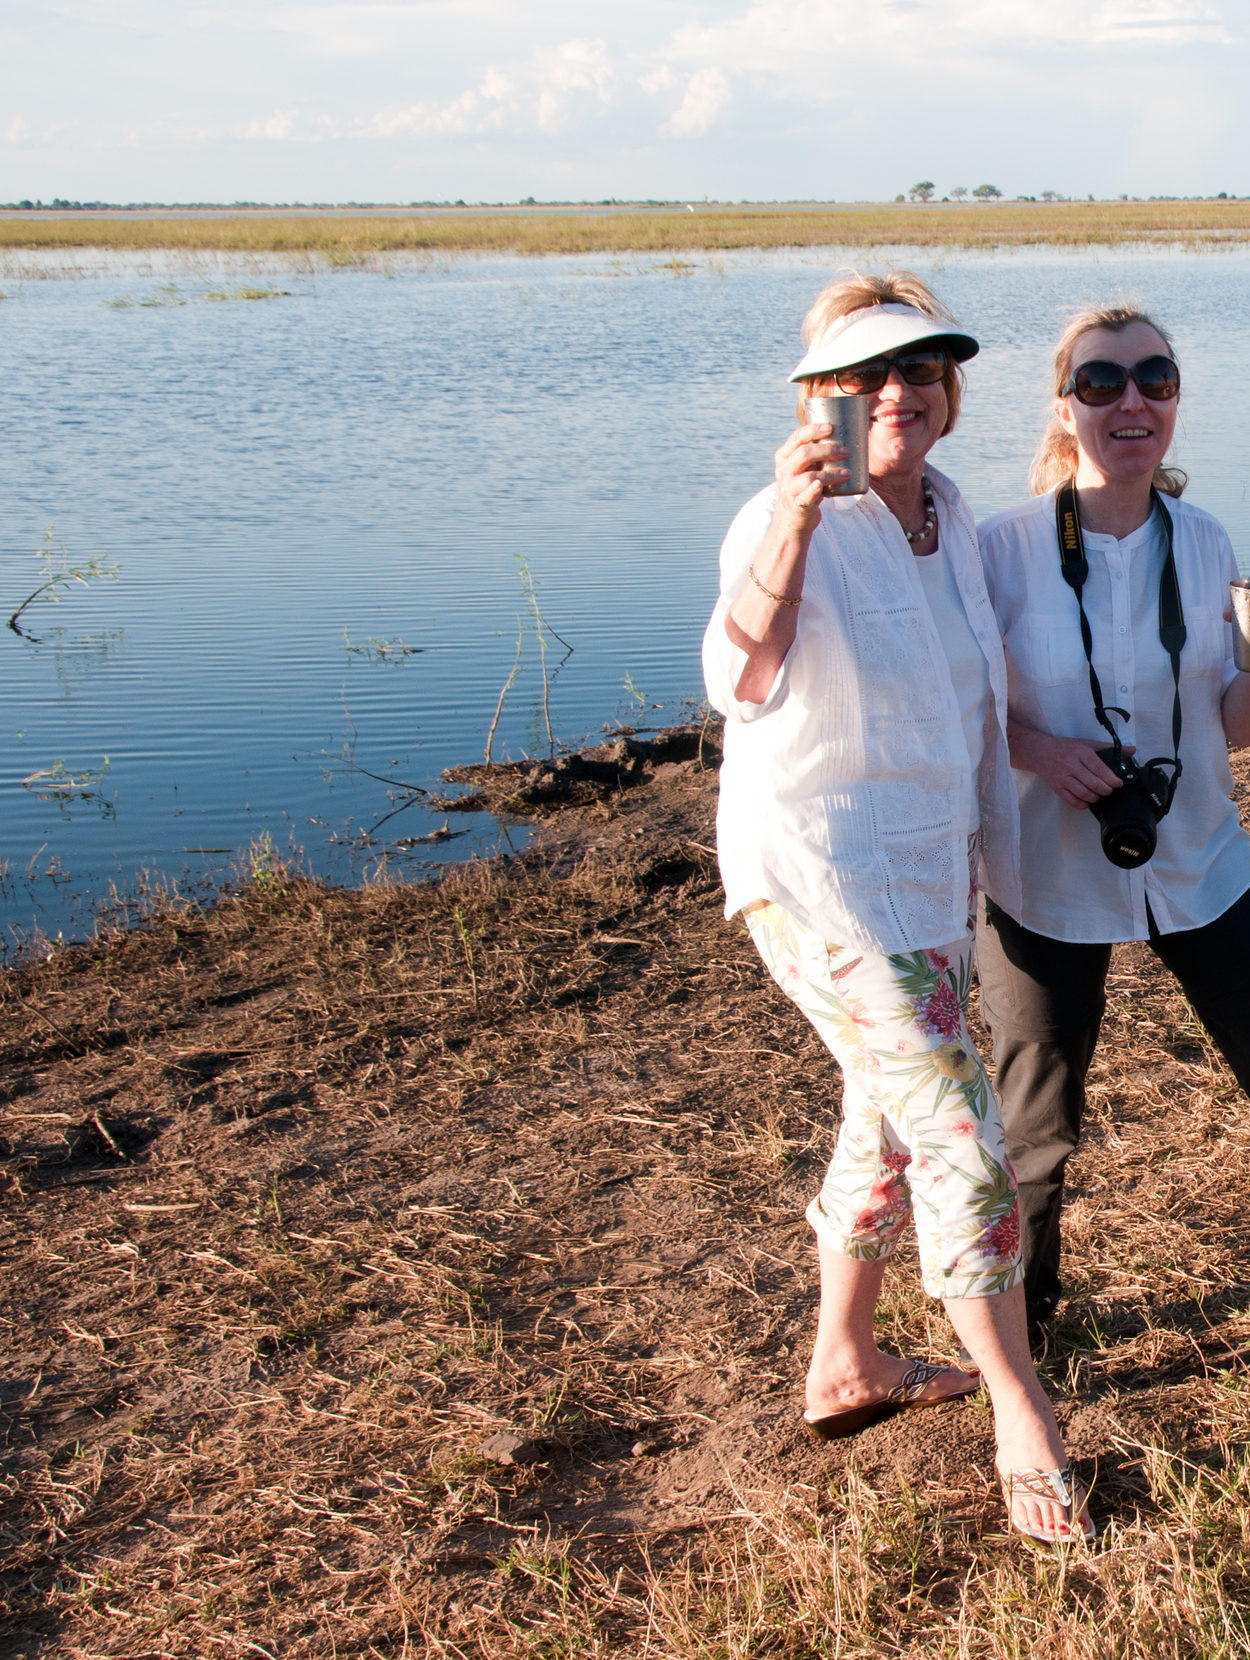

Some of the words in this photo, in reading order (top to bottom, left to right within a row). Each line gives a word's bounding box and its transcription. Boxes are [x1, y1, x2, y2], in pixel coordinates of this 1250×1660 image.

[1064, 512, 1077, 549] Nikon
[1150, 793, 1162, 806] Nikon
[1120, 846, 1140, 857] Nikon
